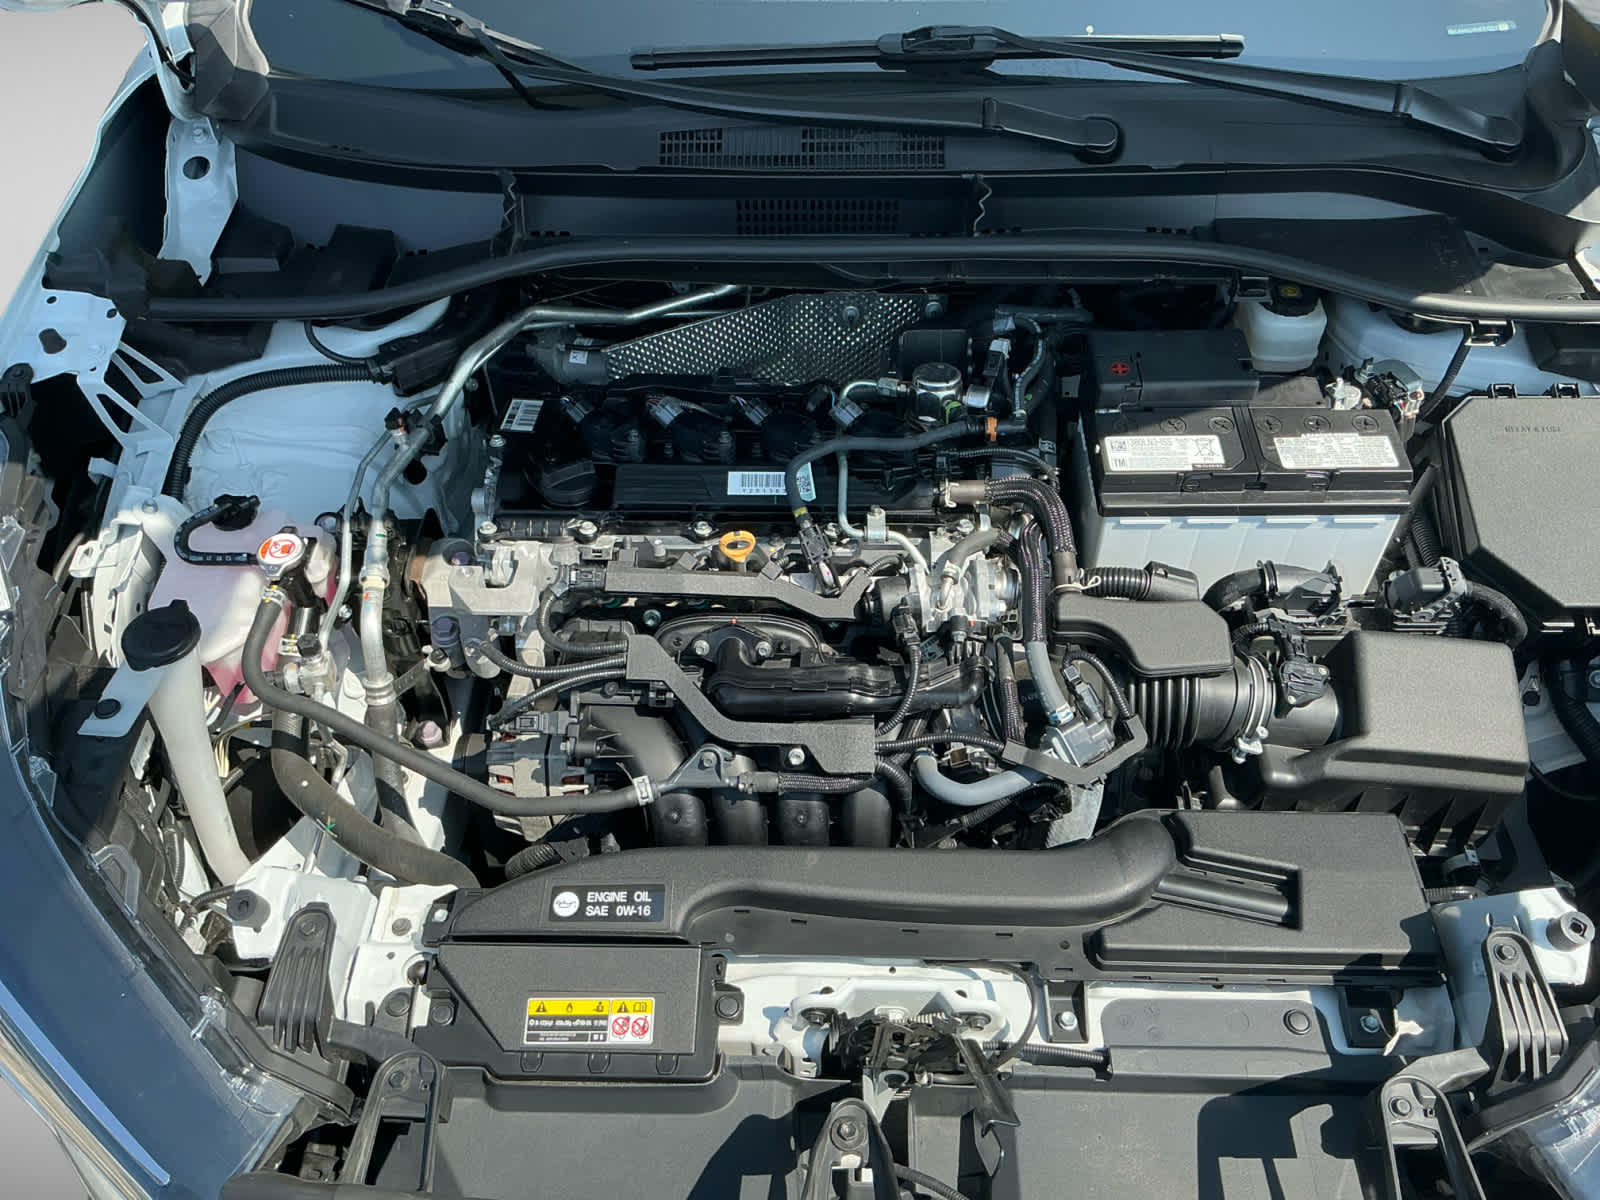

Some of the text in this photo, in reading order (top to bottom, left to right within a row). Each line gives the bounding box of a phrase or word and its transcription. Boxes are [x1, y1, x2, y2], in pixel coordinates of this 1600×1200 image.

[586, 891, 652, 903] ENGINE OIL
[585, 905, 651, 917] SAE 0W-16
